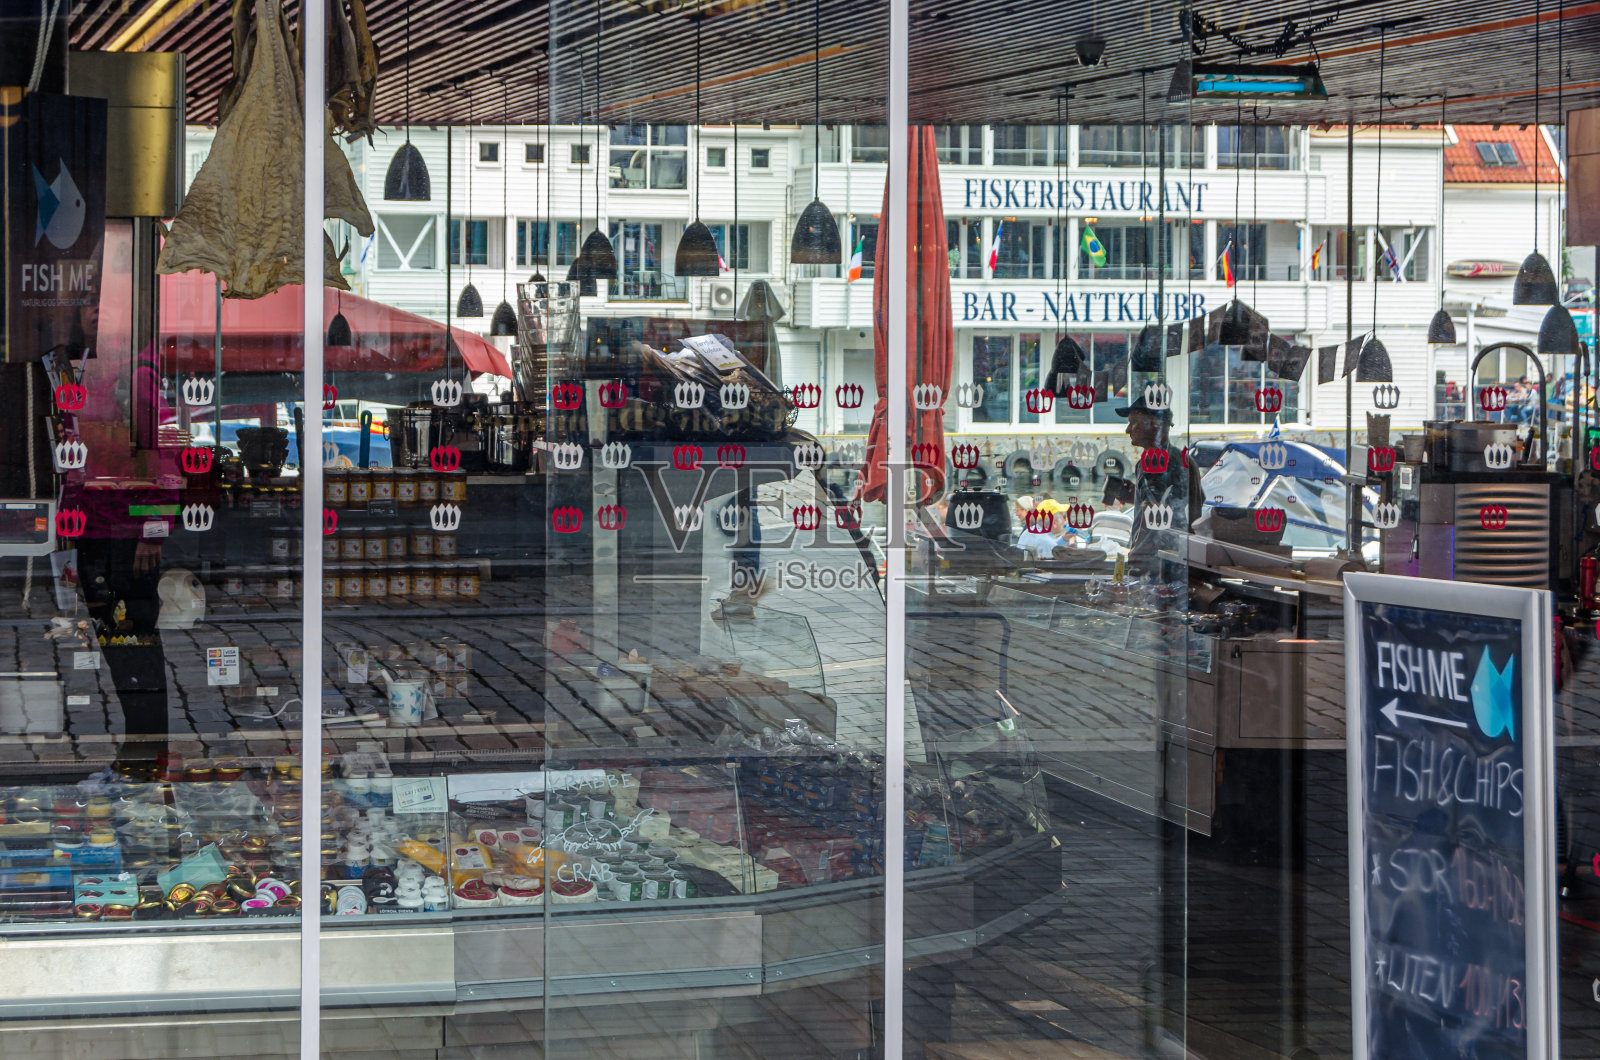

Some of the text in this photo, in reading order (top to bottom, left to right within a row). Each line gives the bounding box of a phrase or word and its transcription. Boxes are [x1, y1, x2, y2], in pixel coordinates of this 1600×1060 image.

[964, 178, 1209, 212] FISKERESTAURANT
[21, 264, 94, 292] FISH ME
[962, 291, 1019, 321] BAR
[1042, 291, 1207, 322] NATTKLUBB
[1377, 641, 1469, 703] FISH ME
[548, 773, 636, 793] KRABBE
[556, 863, 616, 883] CRAB
[1387, 949, 1455, 1009] LITEN
